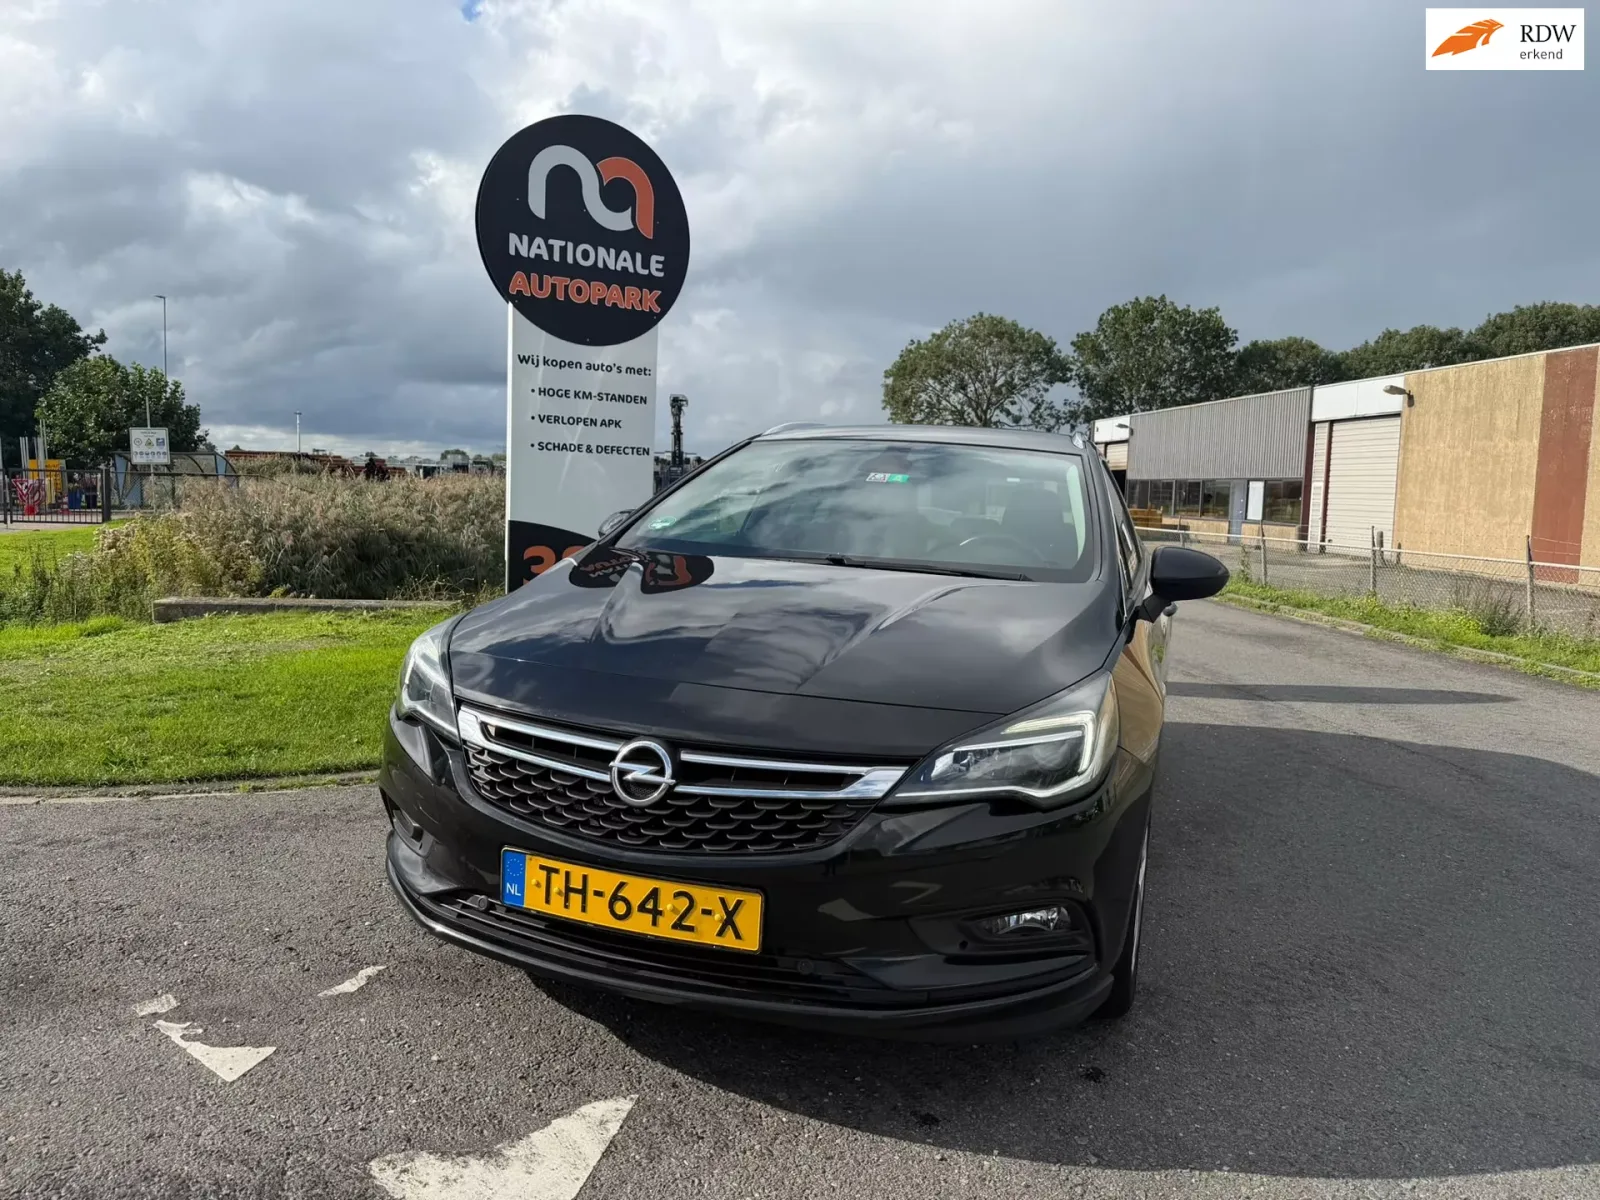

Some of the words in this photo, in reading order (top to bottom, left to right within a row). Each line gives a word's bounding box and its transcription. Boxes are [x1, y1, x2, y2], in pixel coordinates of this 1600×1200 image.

[508, 232, 665, 277] NATIONALE
[508, 271, 662, 313] AUTOPARK
[517, 354, 540, 368] Wij
[543, 356, 582, 370] kopen
[585, 362, 622, 374] auto's
[625, 366, 652, 376] met:
[538, 387, 571, 399] HOGE
[573, 390, 648, 405] KM-STANDEN
[538, 414, 598, 427] VERLOPEN
[599, 419, 622, 429] APK
[537, 441, 584, 453] SCHADE
[585, 444, 594, 454] &
[596, 445, 650, 456] DEFECTEN
[506, 882, 521, 896] NL
[538, 863, 744, 941] TH-642-X
